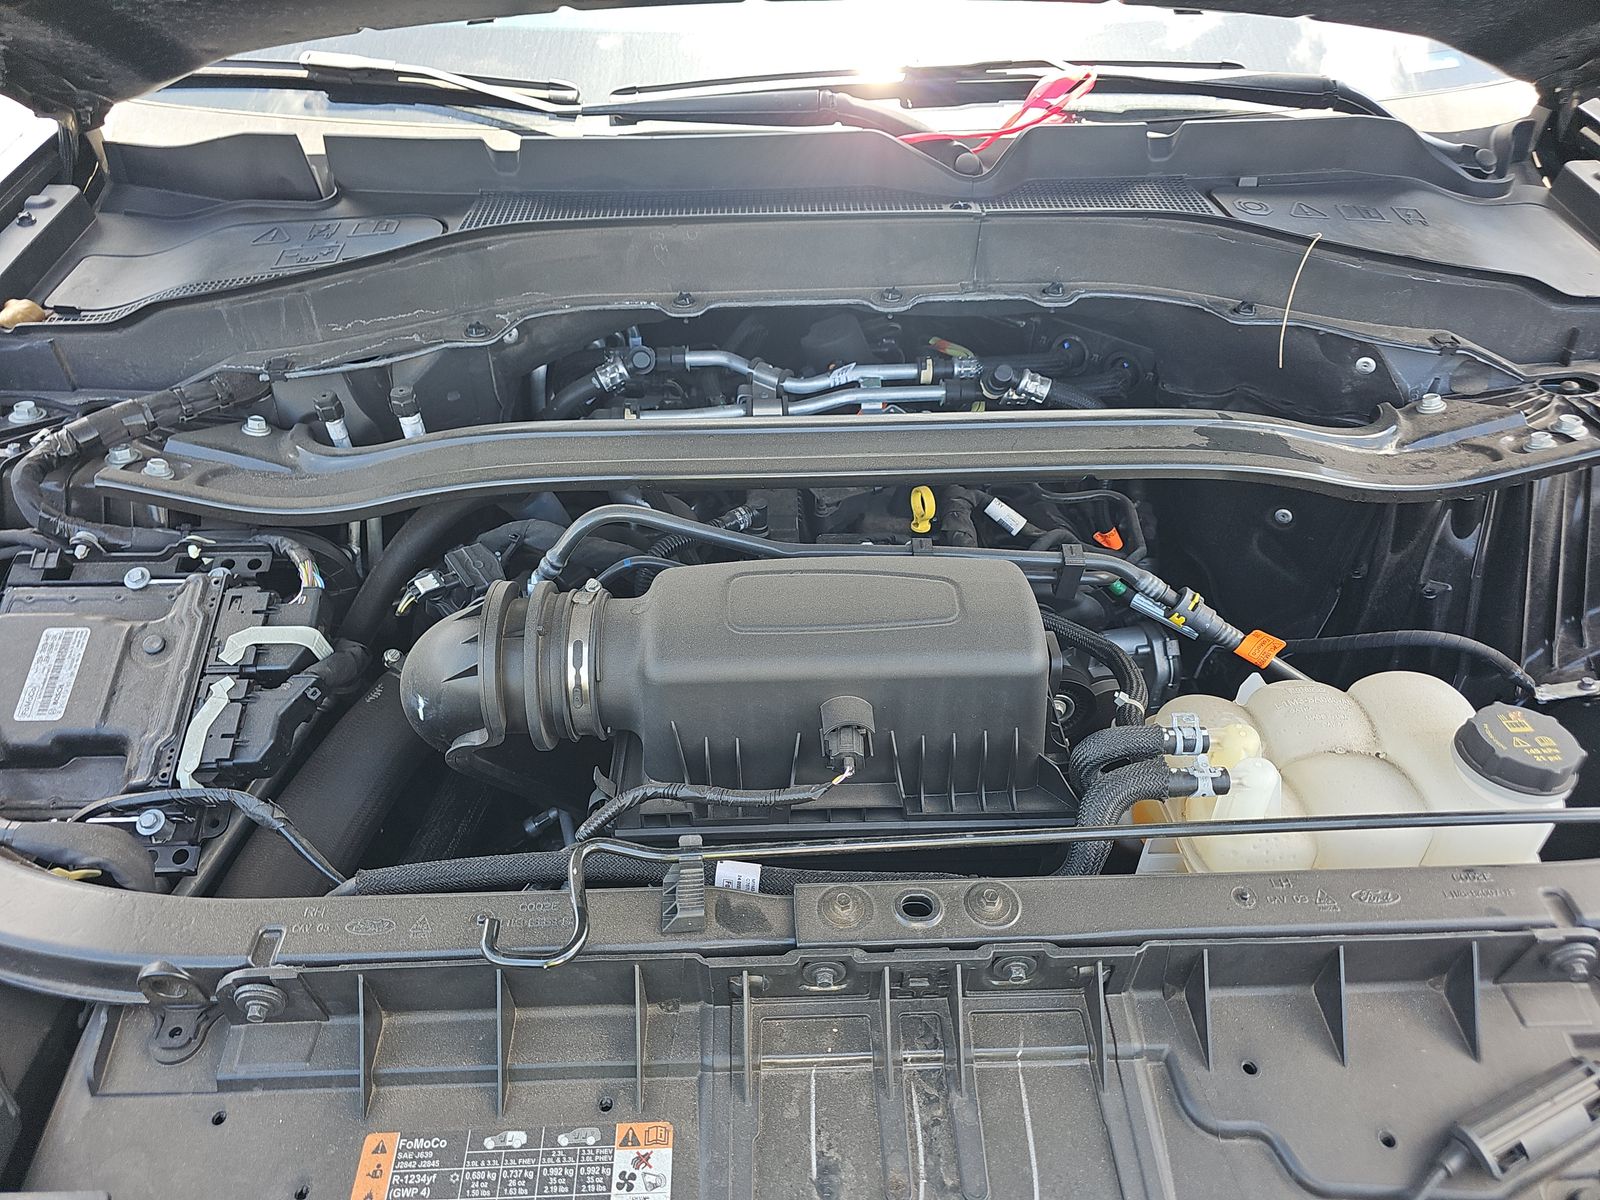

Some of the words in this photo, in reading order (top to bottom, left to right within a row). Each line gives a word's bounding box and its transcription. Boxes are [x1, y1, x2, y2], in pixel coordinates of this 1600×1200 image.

[1269, 877, 1293, 889] LH
[303, 905, 326, 918] RH
[399, 1137, 448, 1150] FoMoCo
[396, 1151, 414, 1160] SAE
[414, 1150, 434, 1159] J639
[394, 1161, 417, 1169] J2842
[417, 1160, 440, 1168] J2845
[486, 1170, 497, 1181] kg
[502, 1169, 523, 1179] 0.737
[523, 1169, 534, 1180] kg
[542, 1167, 563, 1176] 0.992
[564, 1166, 575, 1177] kg
[580, 1166, 601, 1176] 0.992
[601, 1165, 612, 1176] kg
[392, 1173, 437, 1185] R-1234yf
[508, 1179, 517, 1187] 26
[548, 1177, 557, 1185] 35
[389, 1187, 419, 1200] (GWP
[419, 1186, 431, 1199] 4)
[466, 1189, 480, 1197] 1.50
[504, 1187, 517, 1195] 1.63
[517, 1187, 528, 1195] lbs
[543, 1185, 558, 1193] 2.19
[558, 1185, 569, 1193] lbs
[581, 1184, 596, 1192] 2.19
[596, 1184, 607, 1192] lbs
